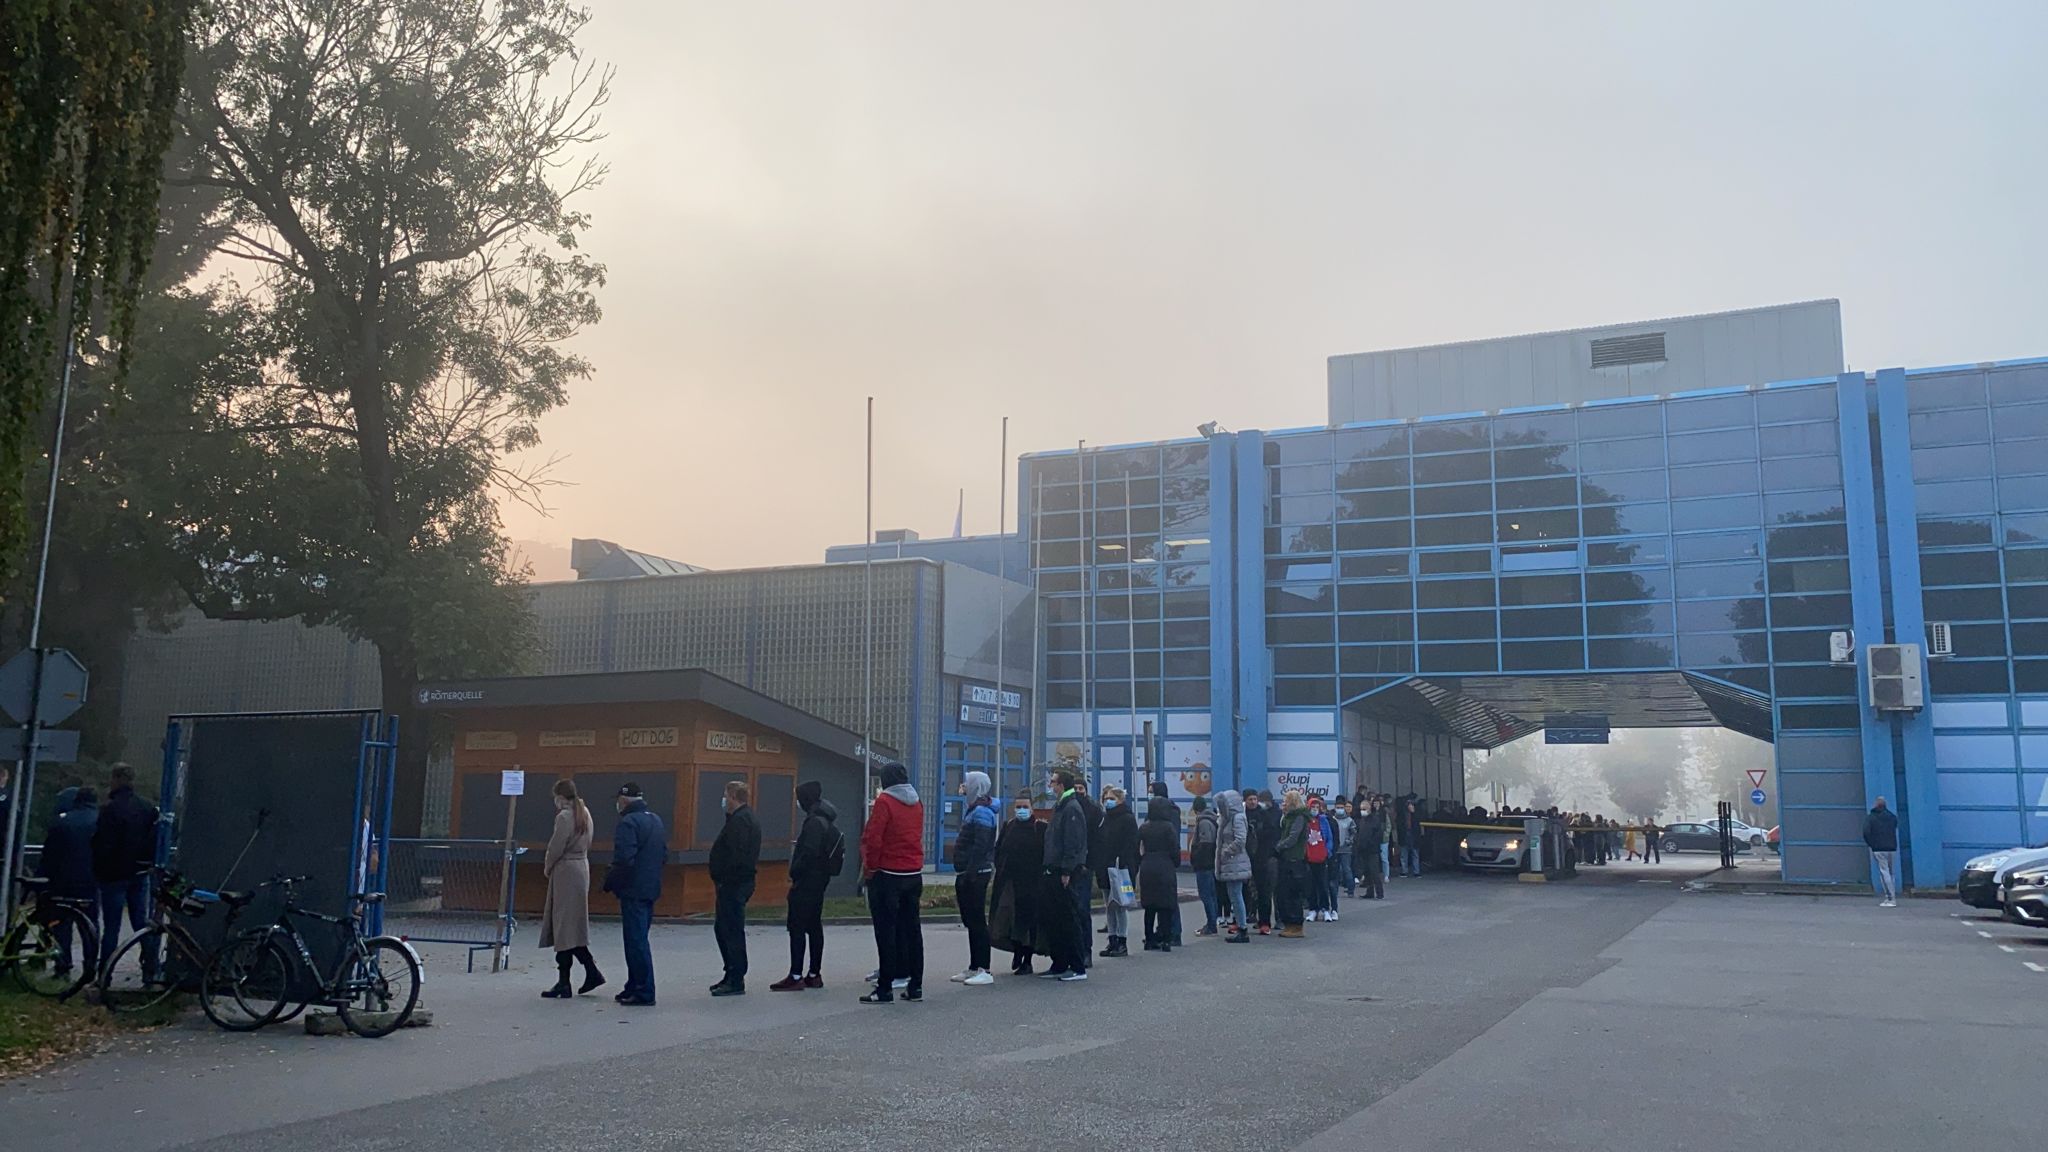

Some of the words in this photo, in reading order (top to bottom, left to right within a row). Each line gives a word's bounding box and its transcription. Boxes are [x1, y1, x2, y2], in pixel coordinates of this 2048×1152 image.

[622, 730, 649, 745] HOT
[650, 728, 675, 744] DOG
[1277, 772, 1311, 787] ekupi
